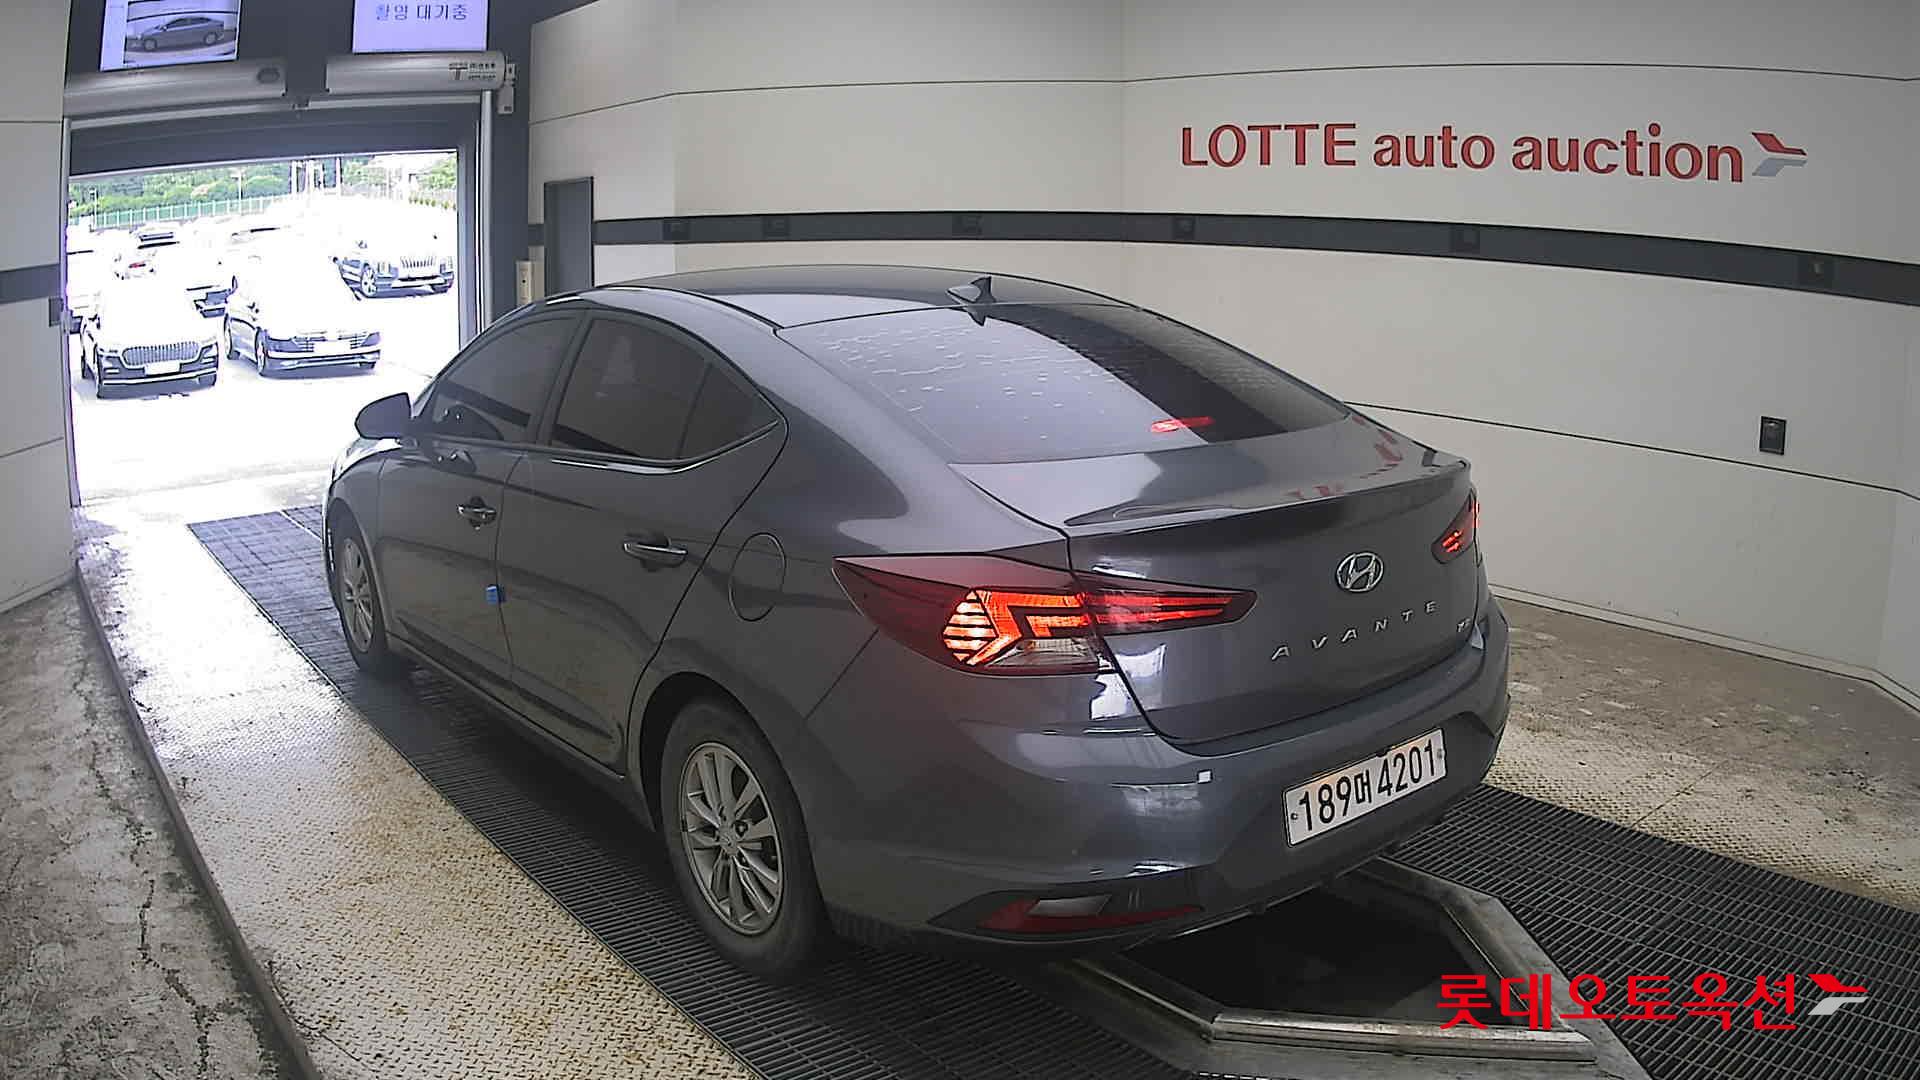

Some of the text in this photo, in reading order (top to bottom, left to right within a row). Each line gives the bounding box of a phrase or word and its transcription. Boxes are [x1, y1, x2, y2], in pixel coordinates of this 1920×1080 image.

[416, 4, 467, 20] 대기중
[1182, 123, 1743, 182] LOTTE auto auction
[1271, 601, 1437, 660] AVANTE
